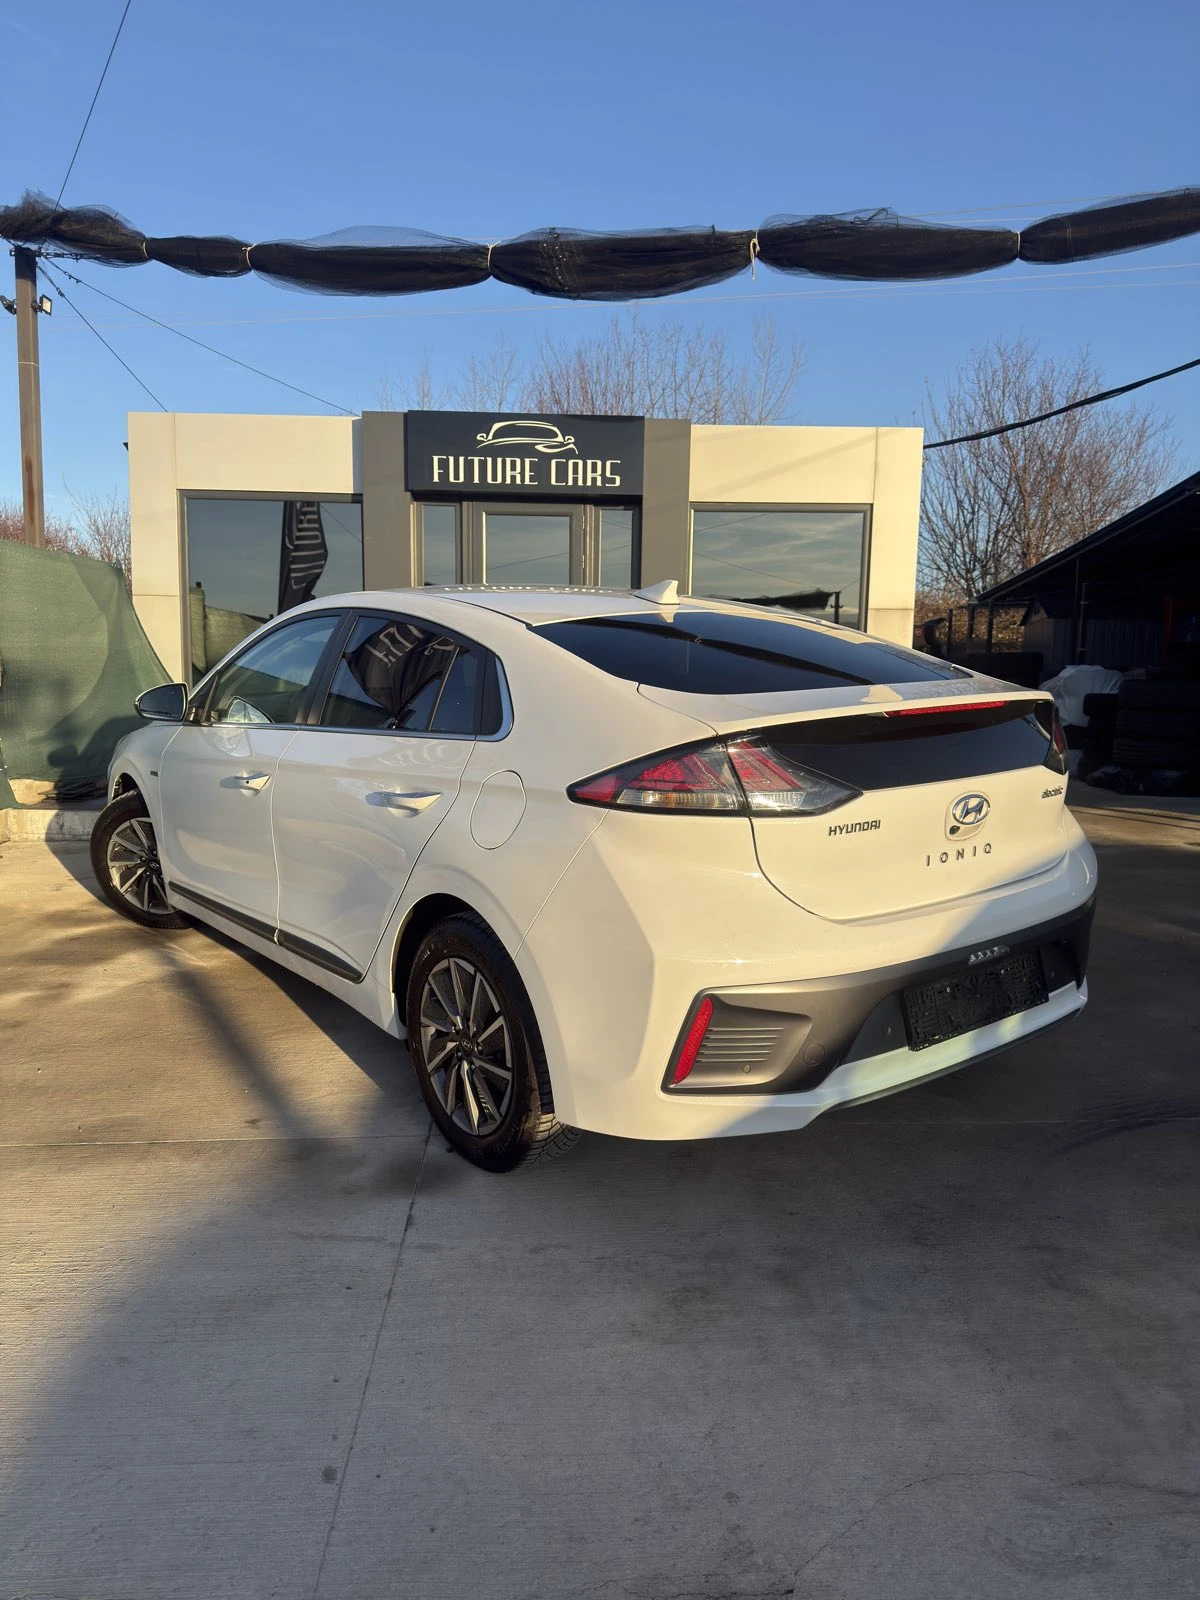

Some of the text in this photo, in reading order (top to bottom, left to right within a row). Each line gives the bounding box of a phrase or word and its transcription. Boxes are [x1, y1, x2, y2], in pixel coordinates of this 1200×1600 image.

[432, 455, 621, 487] FUTURE CARS
[828, 819, 881, 837] HYUNDAI
[926, 843, 993, 867] IONIQ
